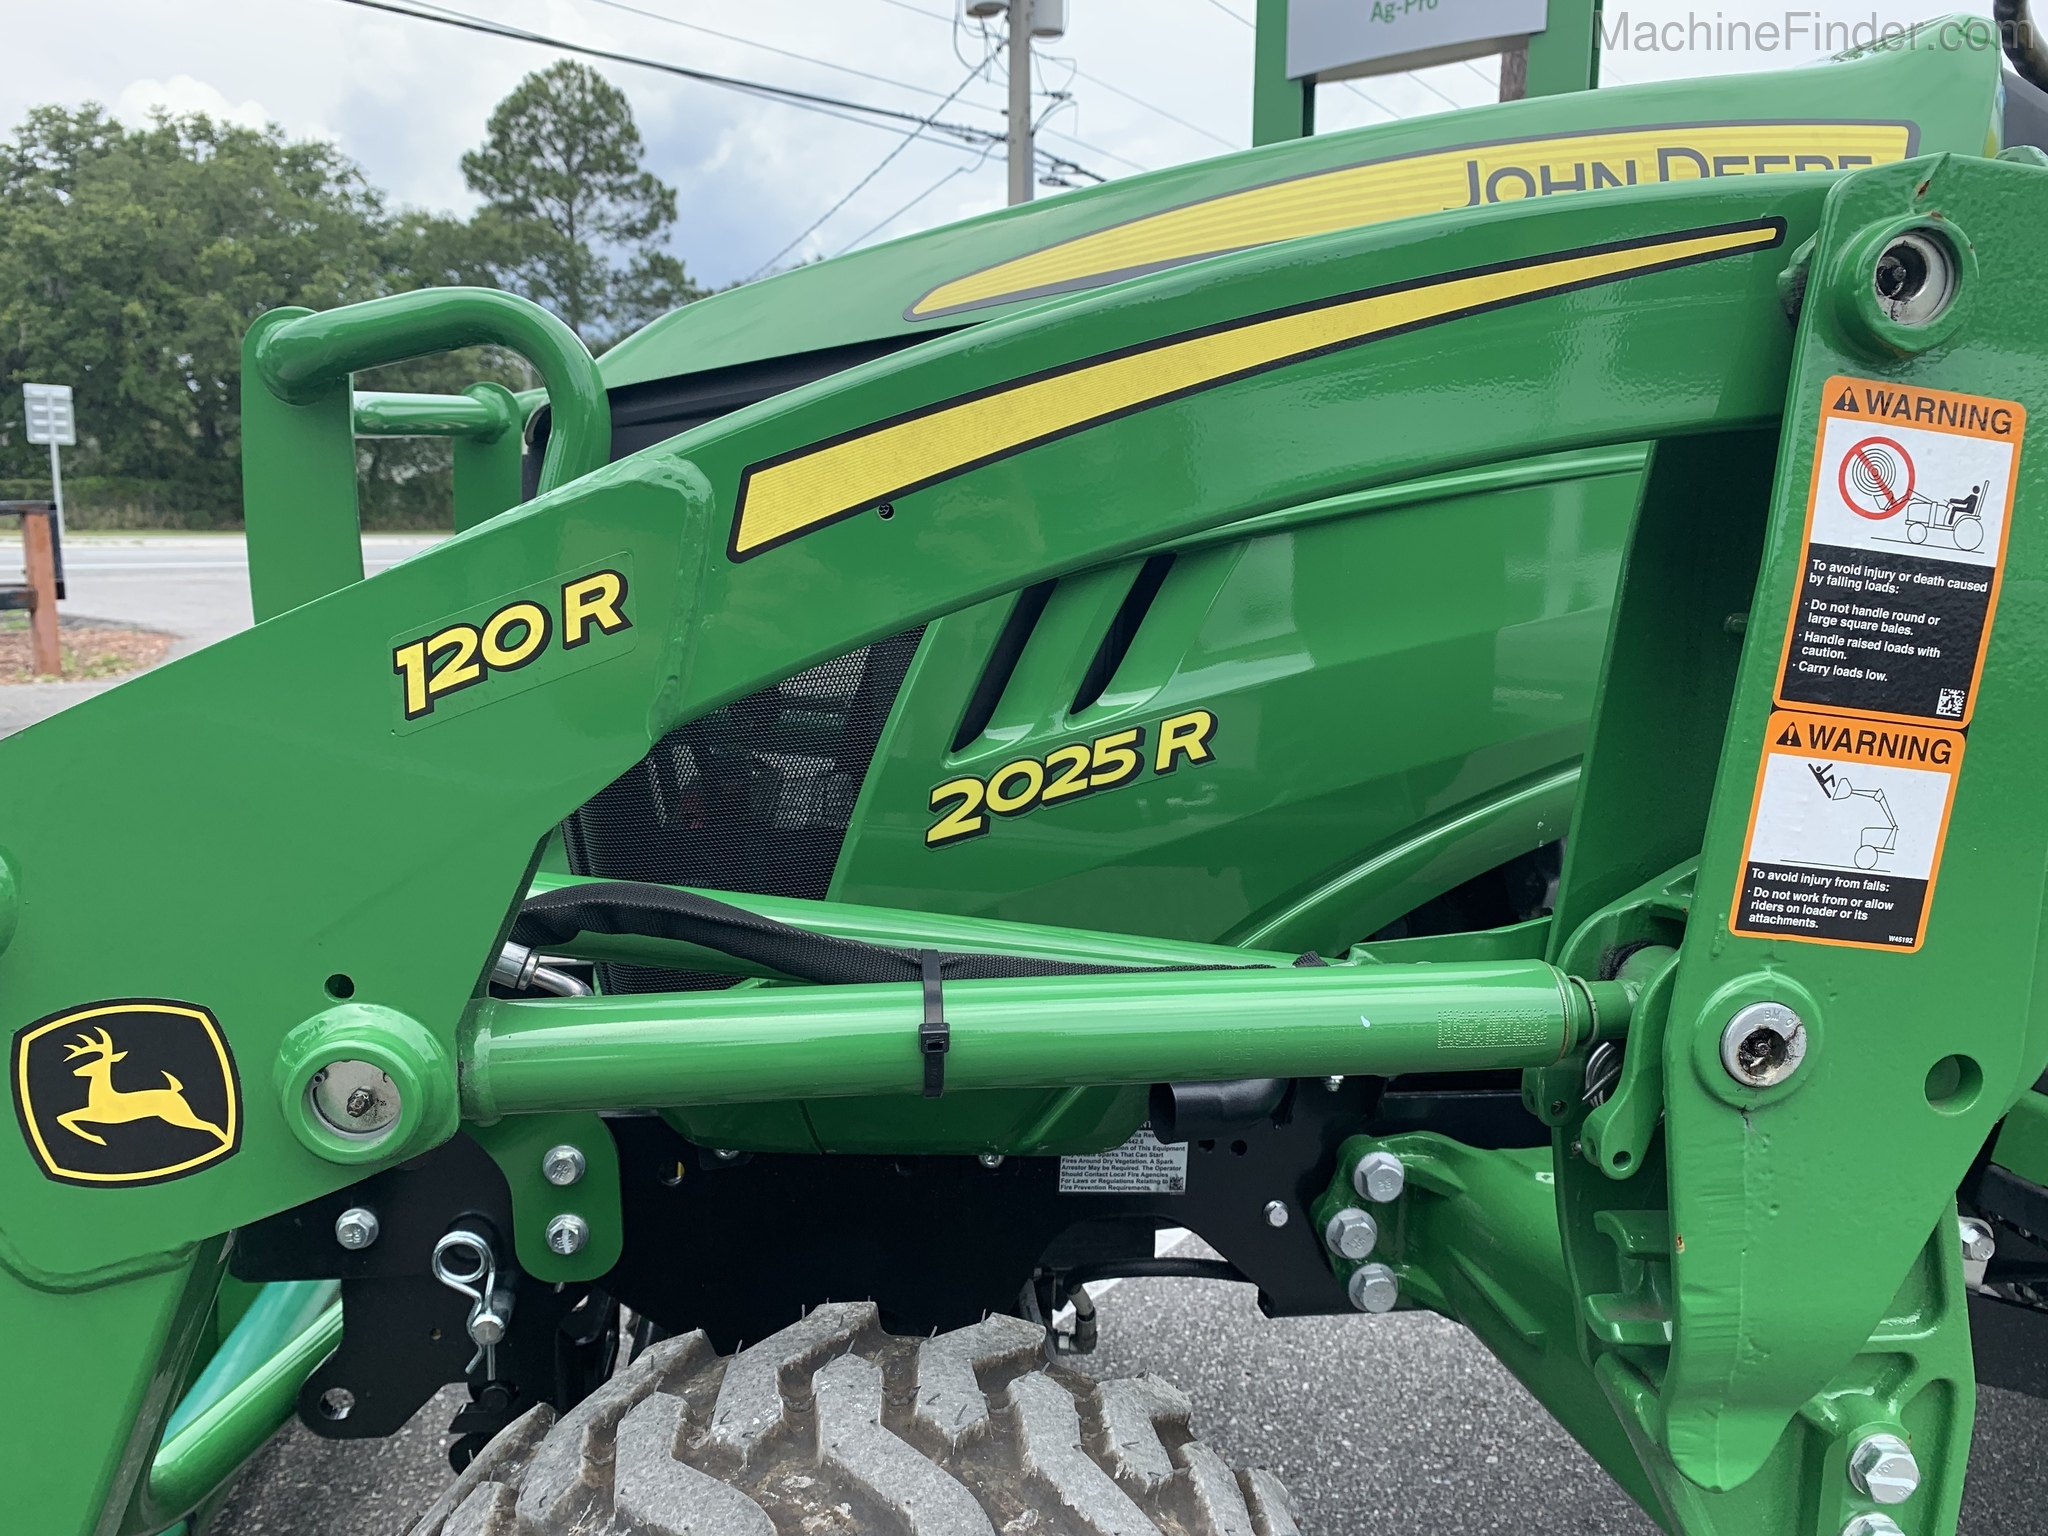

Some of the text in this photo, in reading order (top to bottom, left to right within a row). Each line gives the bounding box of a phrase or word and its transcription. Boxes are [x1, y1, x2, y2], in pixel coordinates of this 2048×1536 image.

[1370, 0, 1437, 23] Ag-Pro
[1443, 160, 1637, 210] JOHN
[1865, 388, 2013, 435] WARNING
[1809, 573, 1899, 594] by falling loads:
[1812, 559, 1988, 593] To avoid injury or death caused
[1807, 612, 1914, 636] large square bales.
[1810, 599, 1941, 626] Do not handle round or
[393, 569, 633, 721] 120 R
[1801, 645, 1847, 660] caution.
[1804, 631, 1941, 659] Handle raised loads with
[1798, 660, 1888, 682] Carry loads low.
[1809, 724, 1952, 764] WARNING
[923, 708, 1217, 849] 2025 R
[1752, 868, 1890, 892] To avoid injury from falls:
[1751, 900, 1868, 921] riders on loader or its
[1753, 886, 1894, 911] Do not work from or allow
[1749, 913, 1819, 928] attachments.
[1888, 935, 1914, 944] W45192
